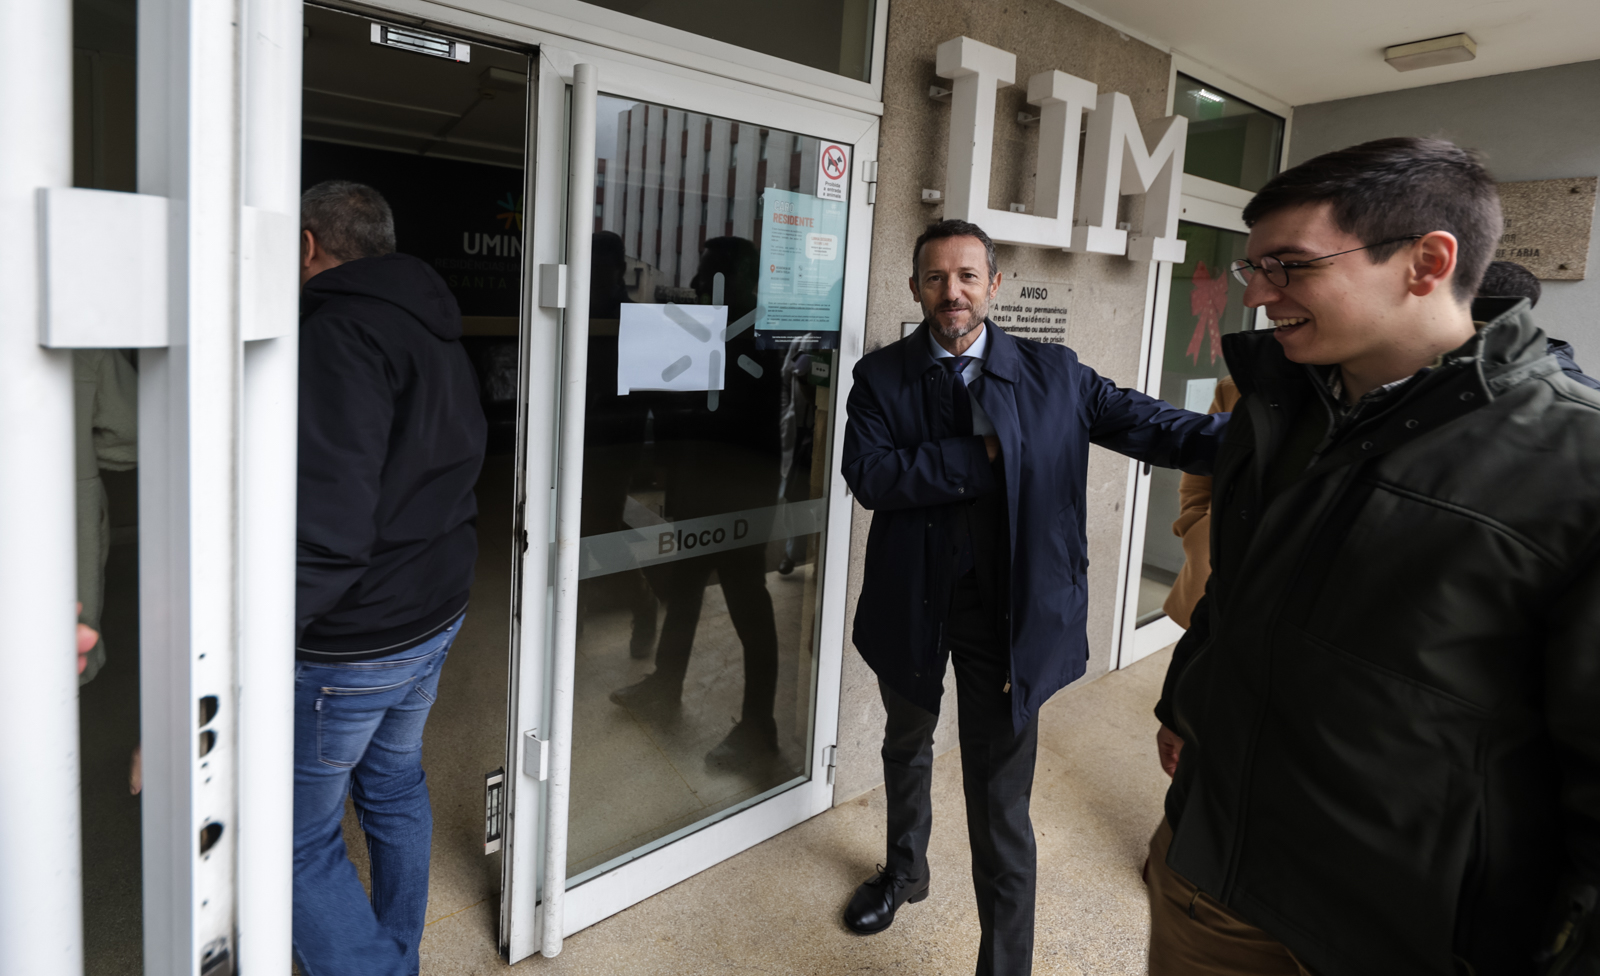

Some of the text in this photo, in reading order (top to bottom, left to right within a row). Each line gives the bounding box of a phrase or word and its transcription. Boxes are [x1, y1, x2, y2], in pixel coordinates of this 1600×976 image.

[936, 35, 1188, 264] UM
[773, 199, 795, 213] CARO
[773, 212, 815, 228] RESIDENTE
[463, 231, 522, 257] UMIN
[1510, 248, 1540, 257] FARIA
[448, 274, 508, 290] SANTA
[1020, 287, 1048, 300] AVISO
[994, 303, 999, 311] A
[1001, 304, 1023, 312] entrada
[1034, 306, 1067, 314] permanência
[1016, 315, 1050, 323] Residência
[1038, 326, 1066, 335] autorização
[1050, 336, 1065, 344] prisão
[657, 518, 749, 555] Bloco D
